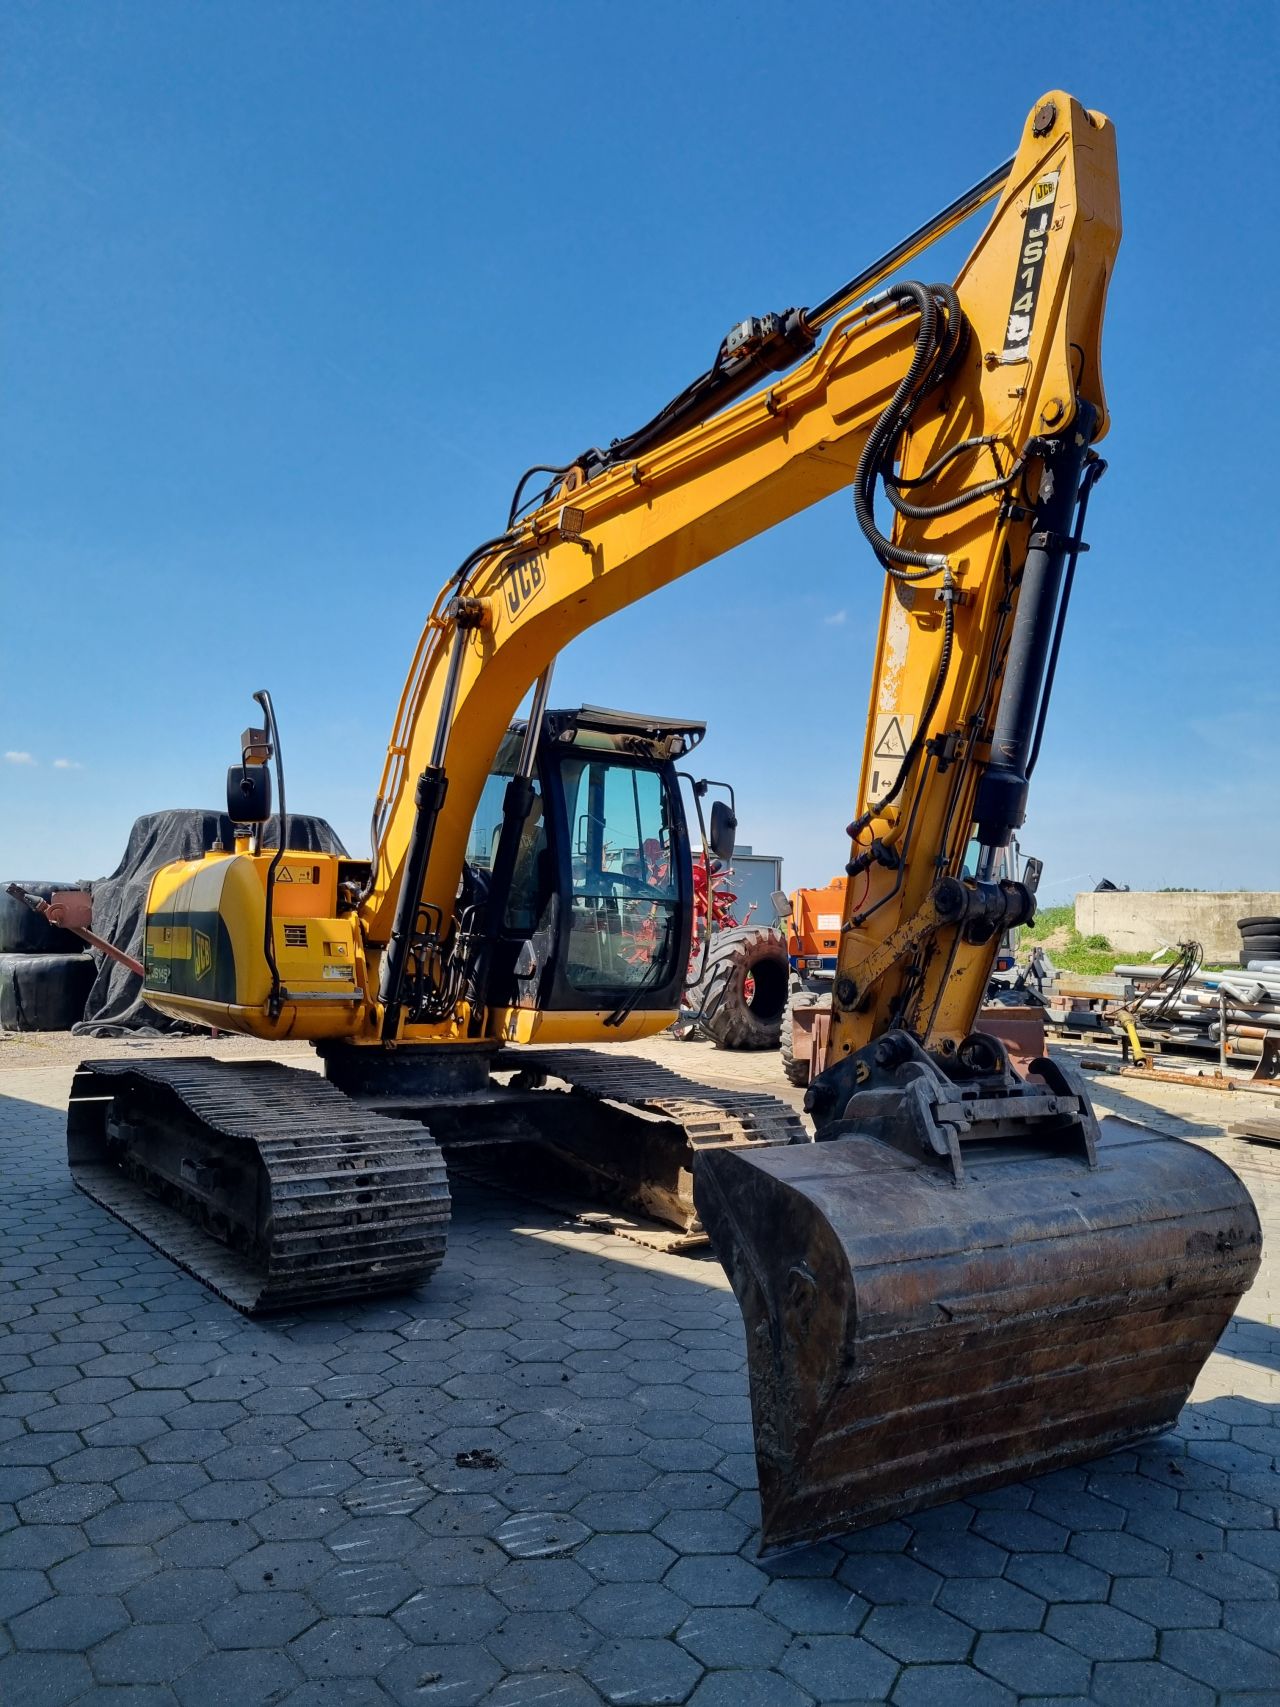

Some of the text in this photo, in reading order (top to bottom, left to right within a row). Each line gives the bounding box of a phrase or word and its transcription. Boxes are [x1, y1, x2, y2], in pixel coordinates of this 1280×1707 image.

[1037, 182, 1053, 199] JCB
[508, 554, 542, 614] JCB
[195, 934, 210, 978] JCB
